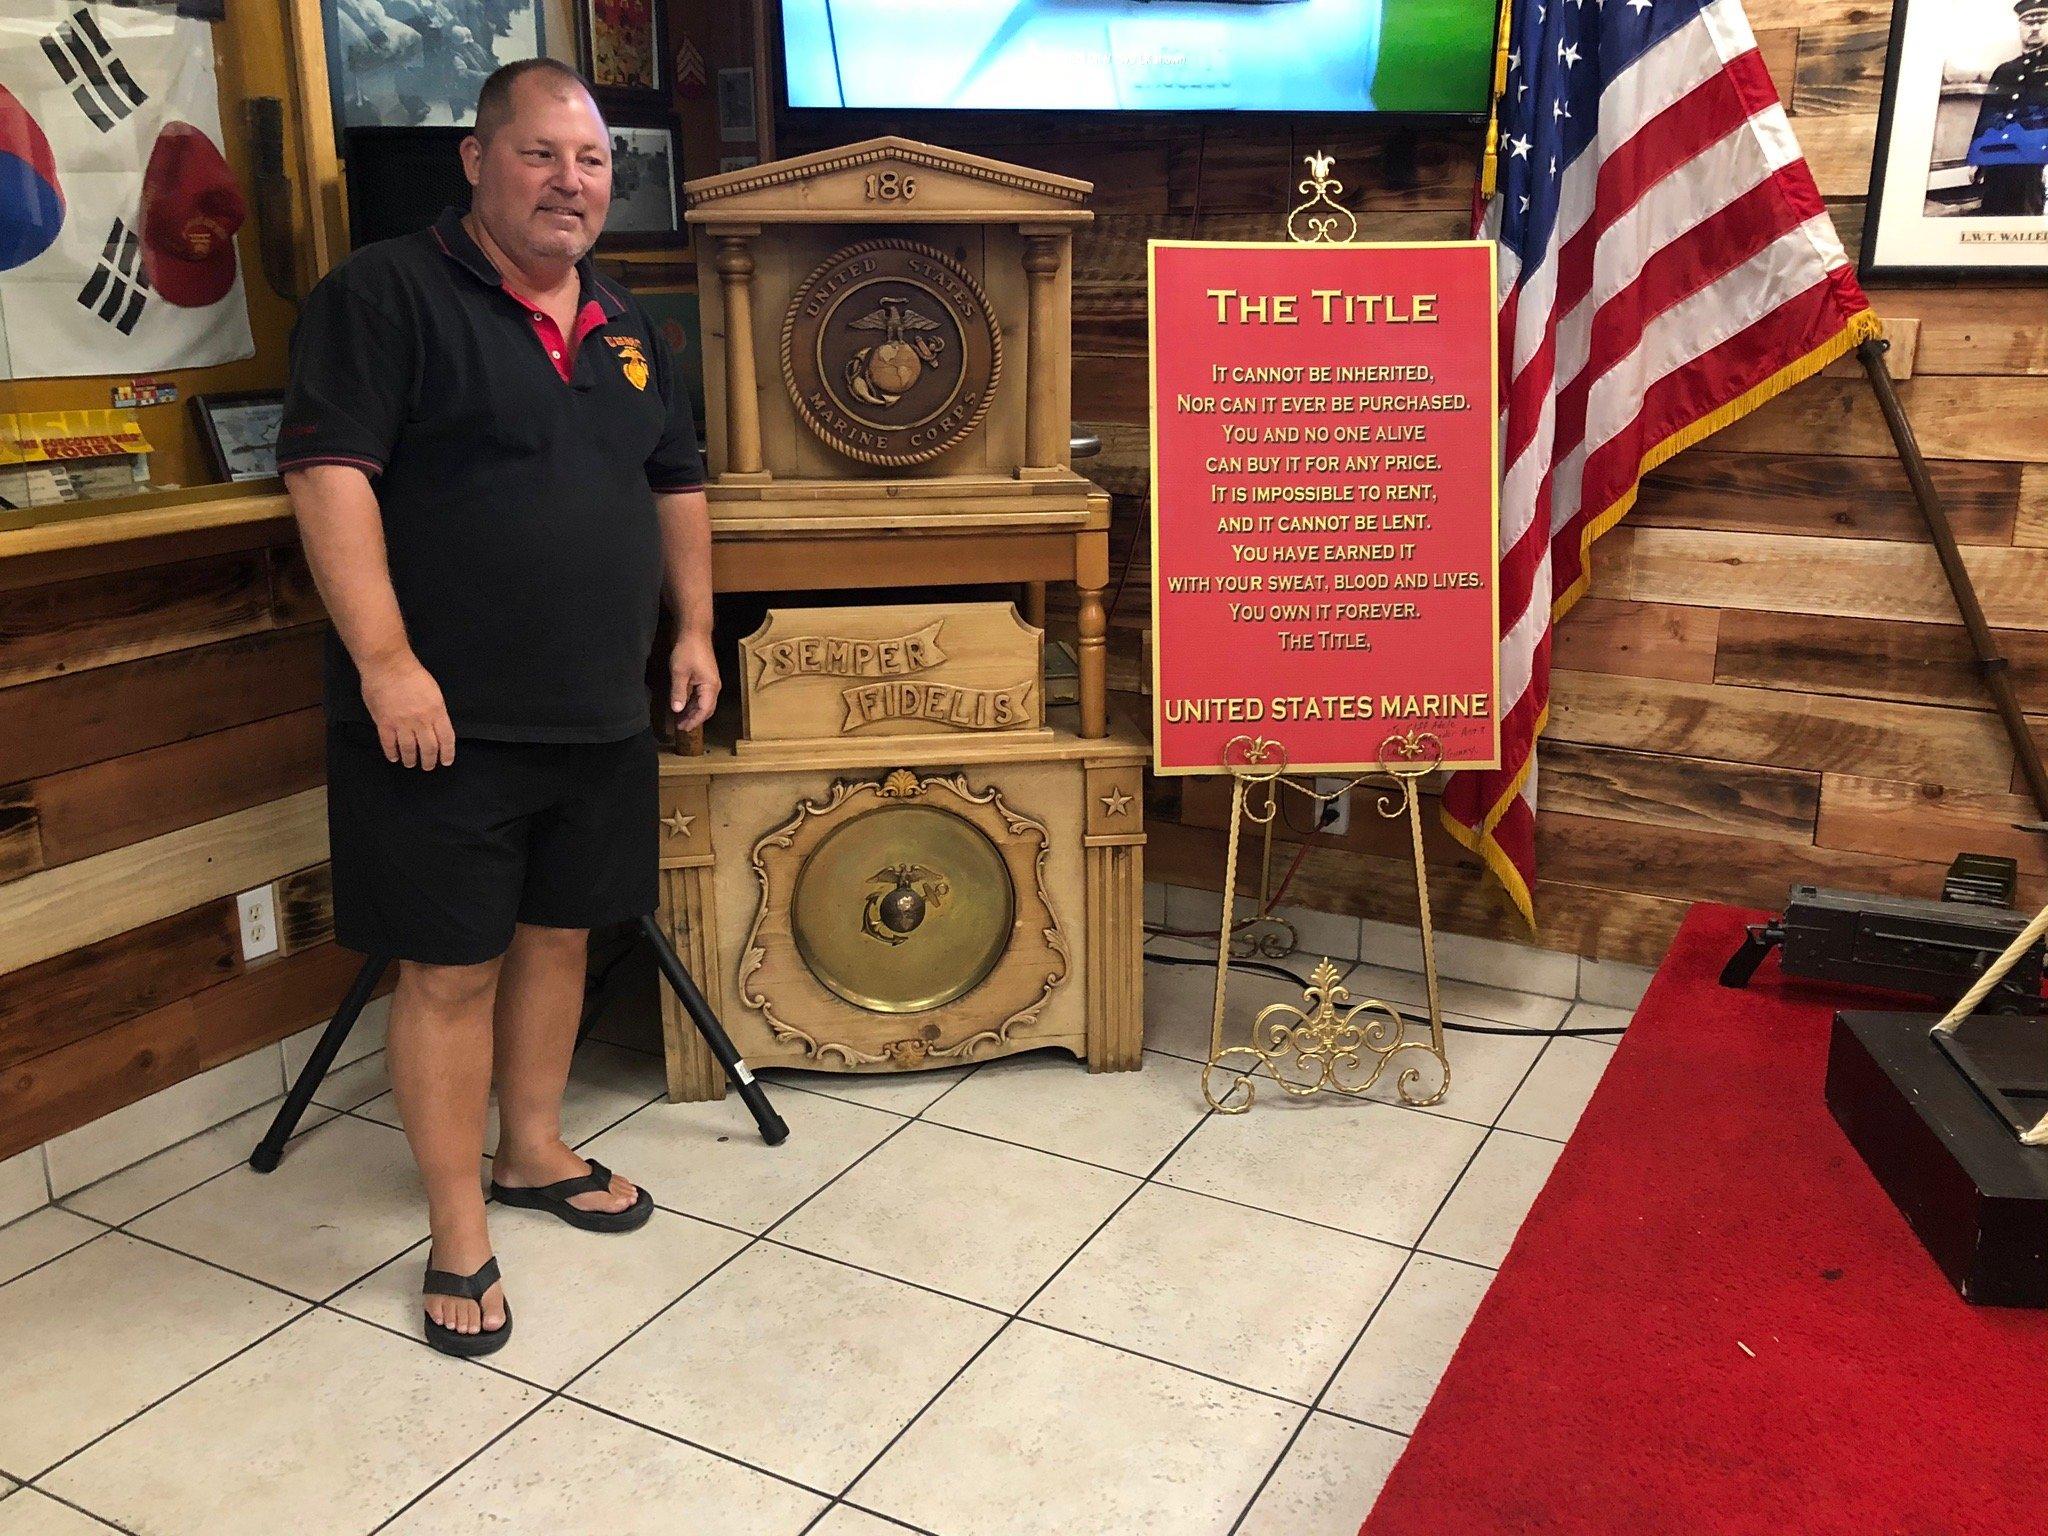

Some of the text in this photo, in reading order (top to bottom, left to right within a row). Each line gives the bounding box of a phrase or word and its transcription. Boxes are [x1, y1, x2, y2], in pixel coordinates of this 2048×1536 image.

[866, 170, 917, 200] 186
[806, 258, 977, 318] UNITED STATES
[1206, 288, 1438, 323] THE TITLE
[1212, 363, 1434, 384] IT CANNOT BE INHERITED,
[1177, 393, 1471, 413] NOR CAN IT EVER BE PURCHASED.
[809, 390, 977, 450] MARINE CORPS
[1221, 424, 1426, 442] YOU AND NO ONE ALIVE
[1205, 453, 1442, 472] CAN BUY IT FOR ANY PRICE.
[1211, 483, 1437, 503] IT IS IMPOSSIBLE TO RENT,
[1217, 513, 1431, 532] AND IT CANNOT BE LENT.
[1230, 543, 1416, 562] YOU HAVE EARNED IT
[1167, 571, 1484, 593] WITH YOUR SWEAT, BLOOD AND LIVES.
[1228, 602, 1420, 621] YOU OWN IT FOREVER.
[1277, 630, 1371, 652] THE TITLE,
[771, 636, 929, 676] SEMPER
[857, 684, 1015, 726] FIDELIS
[1165, 693, 1488, 722] UNITED STATES MARINE
